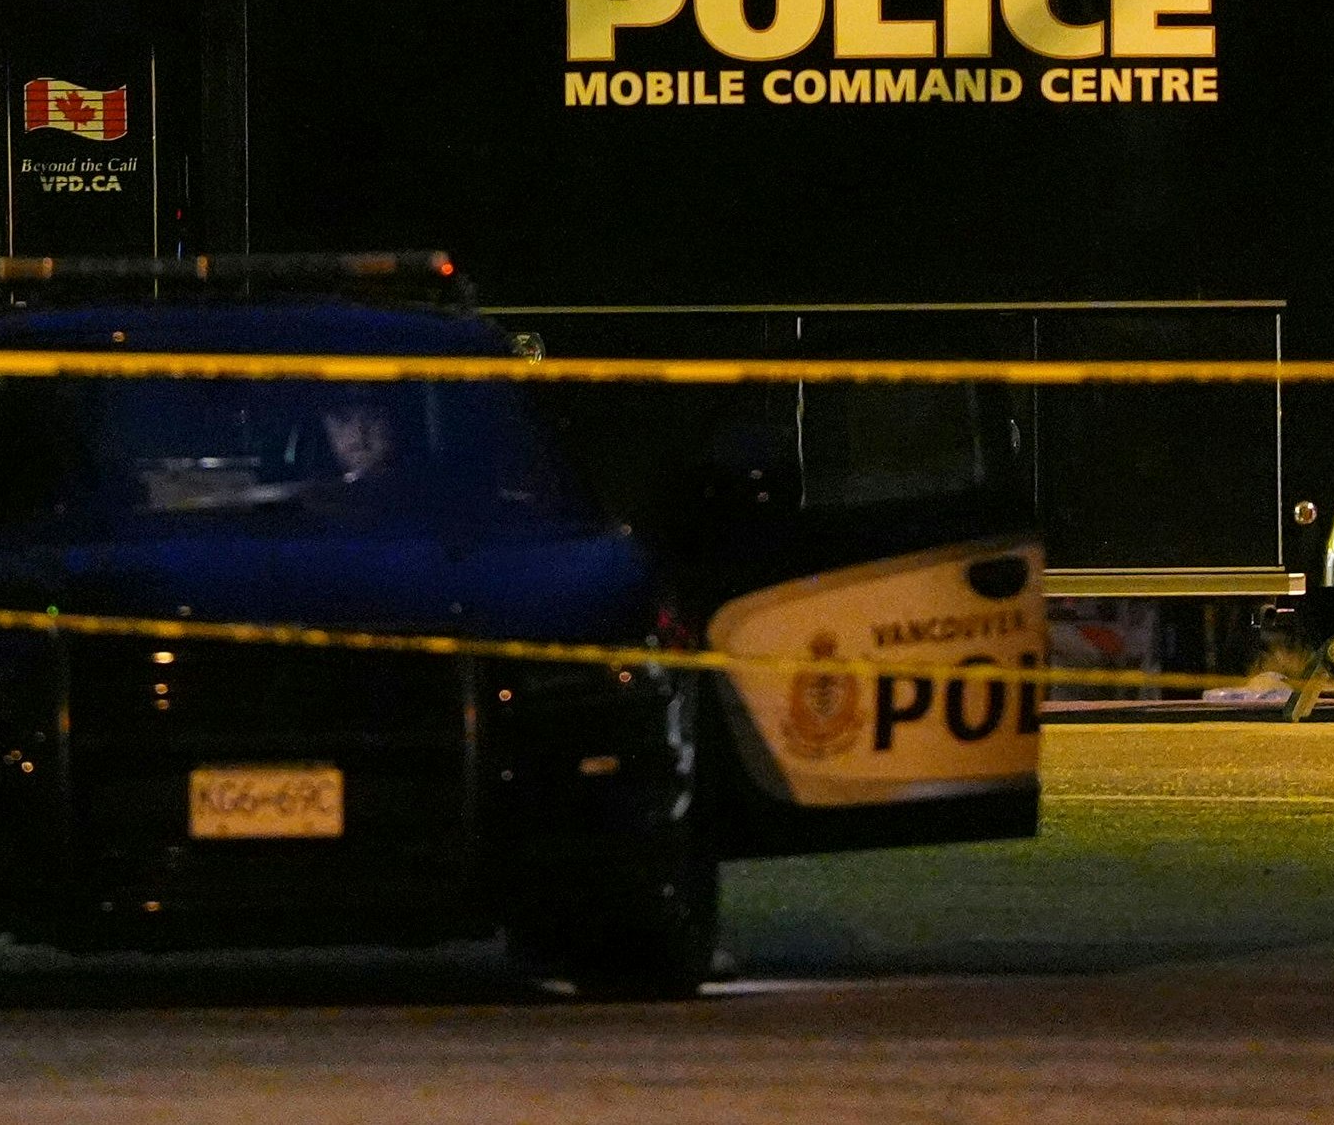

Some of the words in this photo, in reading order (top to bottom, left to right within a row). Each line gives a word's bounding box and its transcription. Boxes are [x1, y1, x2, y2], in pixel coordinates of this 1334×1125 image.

[565, 71, 745, 106] MOBILE
[763, 68, 1023, 103] COMMAND
[1041, 67, 1219, 102] CENTRE
[21, 157, 77, 174] Beyond
[80, 157, 104, 172] the
[107, 157, 138, 172] Call
[40, 175, 122, 192] VPD.CA
[871, 610, 1026, 647] VANCOUVER
